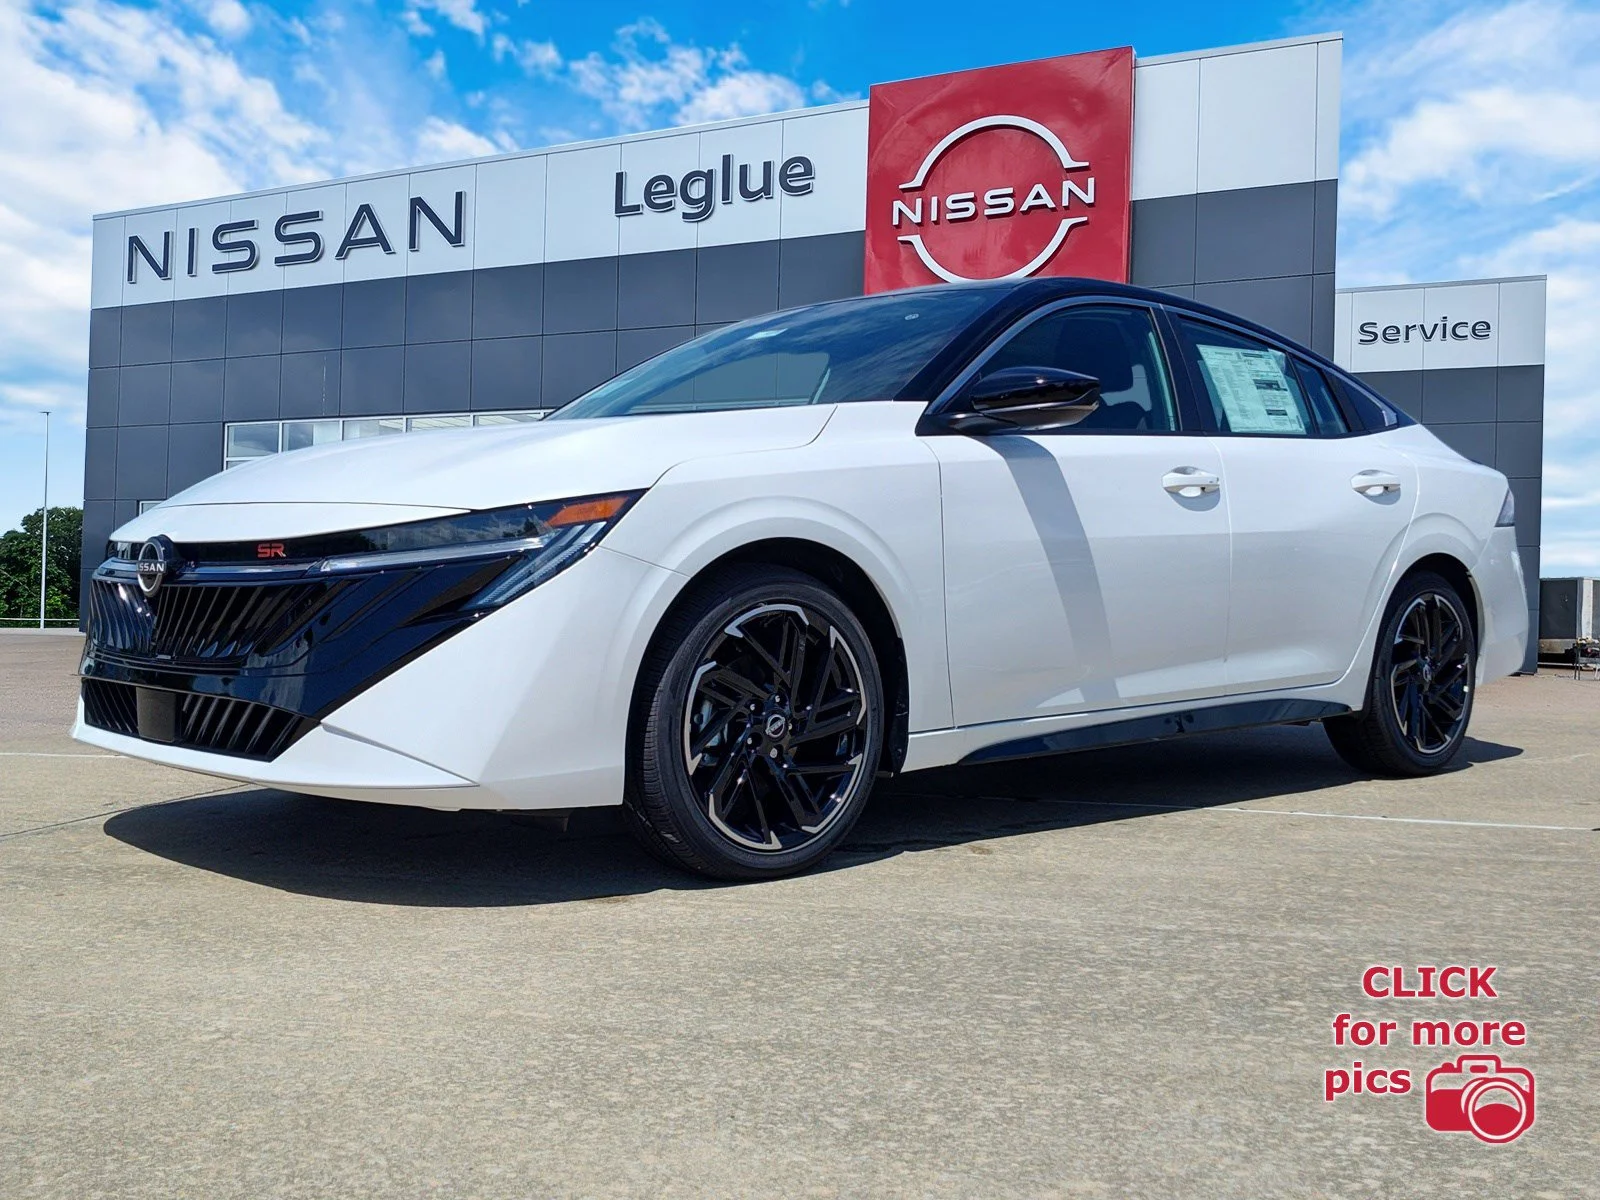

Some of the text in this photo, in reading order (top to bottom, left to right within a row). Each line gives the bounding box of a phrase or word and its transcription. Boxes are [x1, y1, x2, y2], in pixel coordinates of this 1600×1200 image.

[615, 154, 815, 222] Leglue
[892, 177, 1096, 228] NISSAN
[127, 191, 466, 284] NISSAN
[1358, 316, 1491, 345] Service
[136, 561, 166, 573] SSAN
[257, 543, 285, 558] SR
